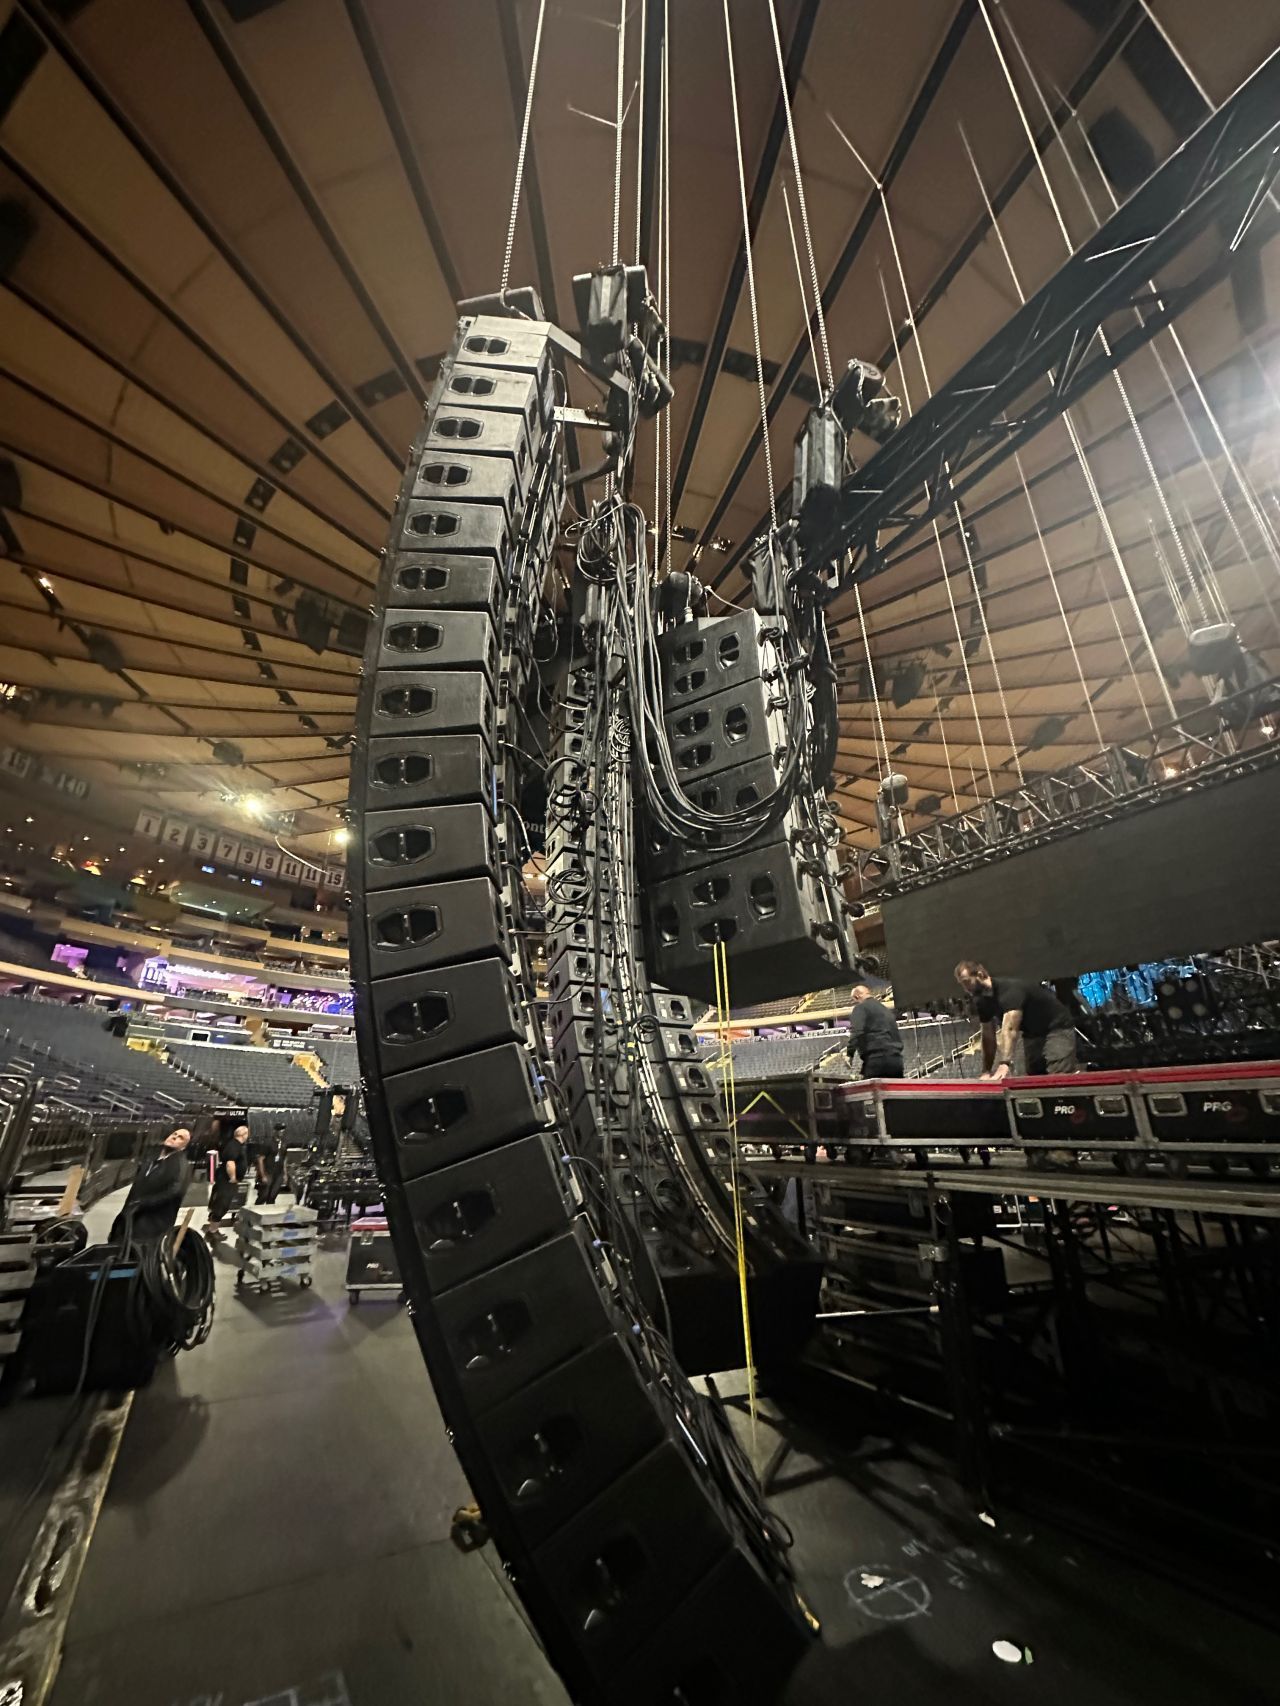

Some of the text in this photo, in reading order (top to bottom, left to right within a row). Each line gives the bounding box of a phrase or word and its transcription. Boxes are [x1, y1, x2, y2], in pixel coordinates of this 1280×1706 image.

[144, 818, 151, 833] 1
[169, 828, 180, 842] 2
[197, 837, 208, 850] 3
[223, 843, 233, 857] 7
[243, 851, 254, 864] 9
[264, 857, 274, 869] 9
[285, 862, 296, 876] 11
[305, 867, 317, 881] 11
[1053, 1105, 1076, 1115] PRG
[1203, 1101, 1233, 1113] PRG
